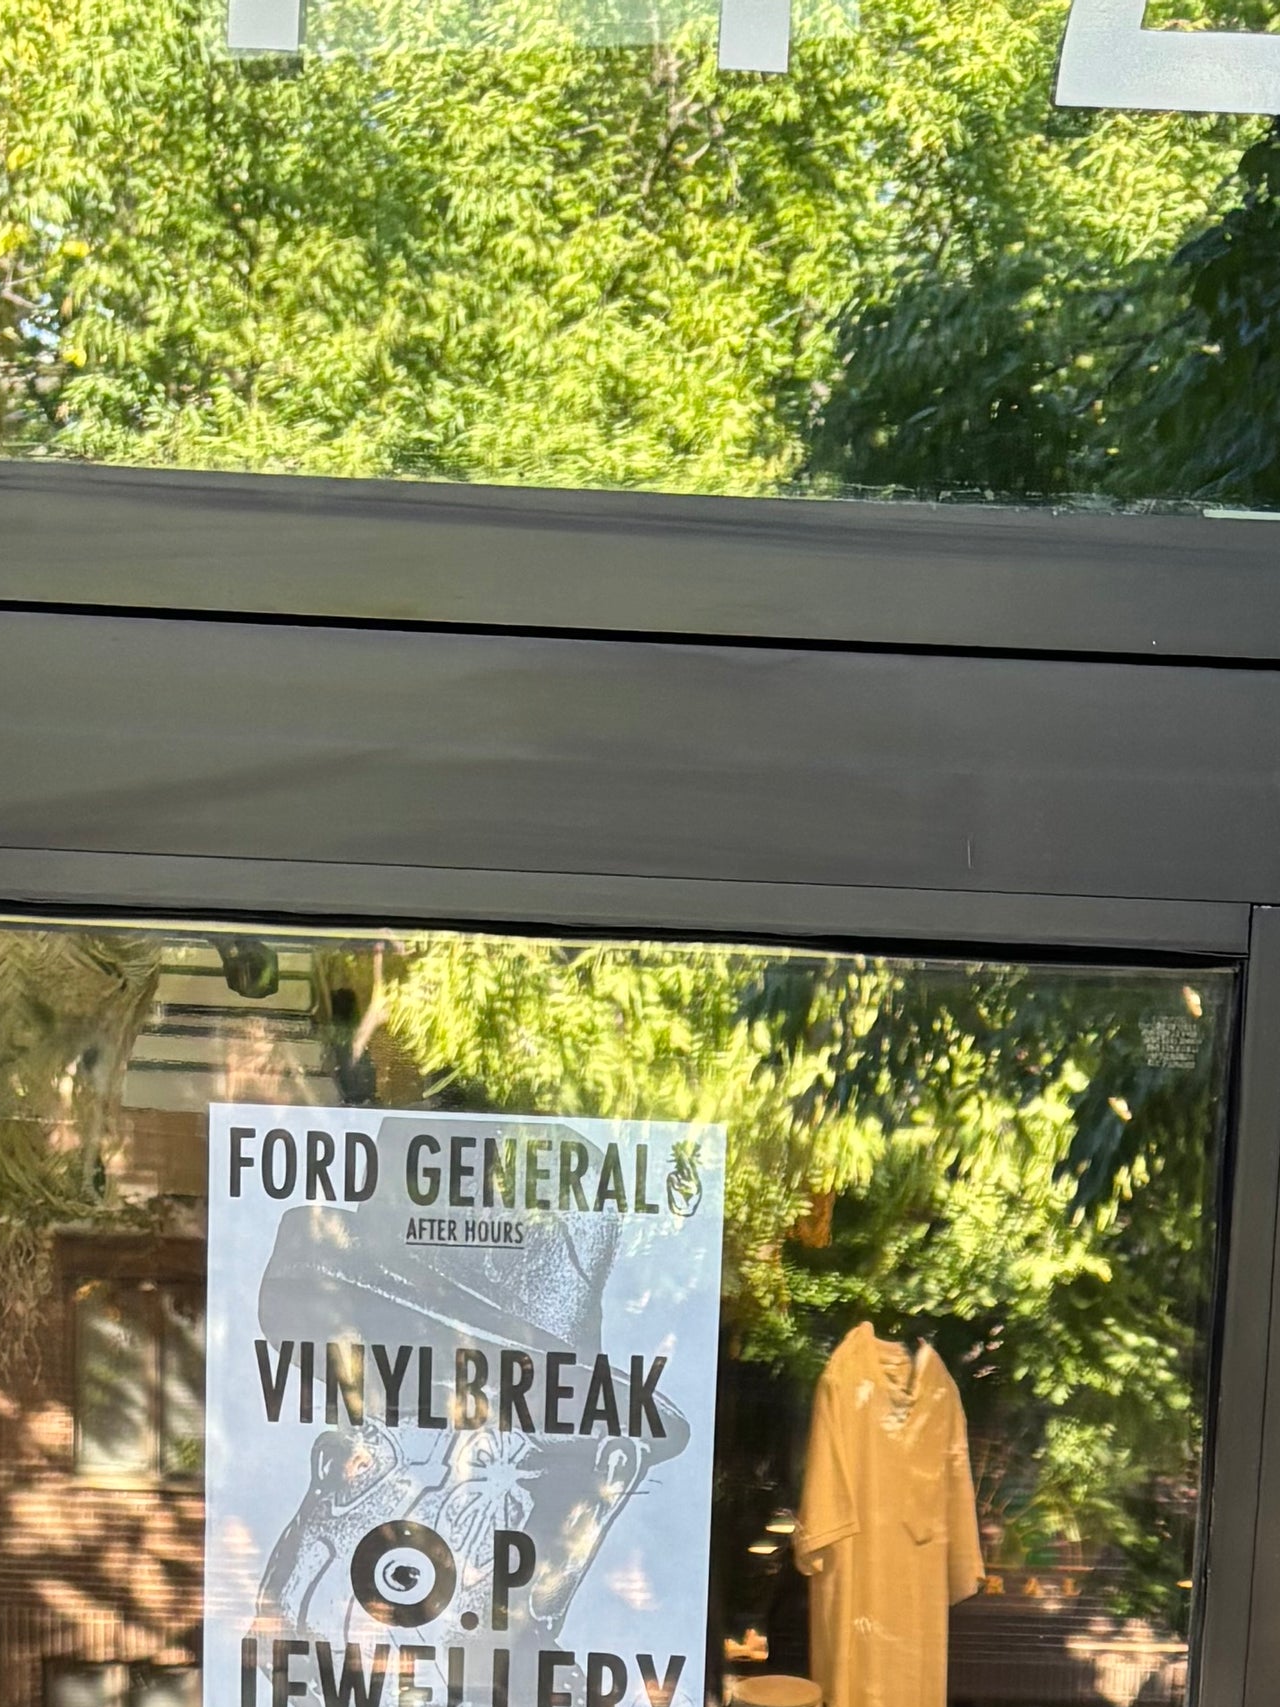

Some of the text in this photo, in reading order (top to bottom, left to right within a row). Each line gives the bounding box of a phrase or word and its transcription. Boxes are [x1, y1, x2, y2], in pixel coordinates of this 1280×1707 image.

[228, 1126, 660, 1215] FORD GENERAL
[406, 1218, 525, 1245] AFTER HOURS
[254, 1339, 668, 1439] VINYLBREAK
